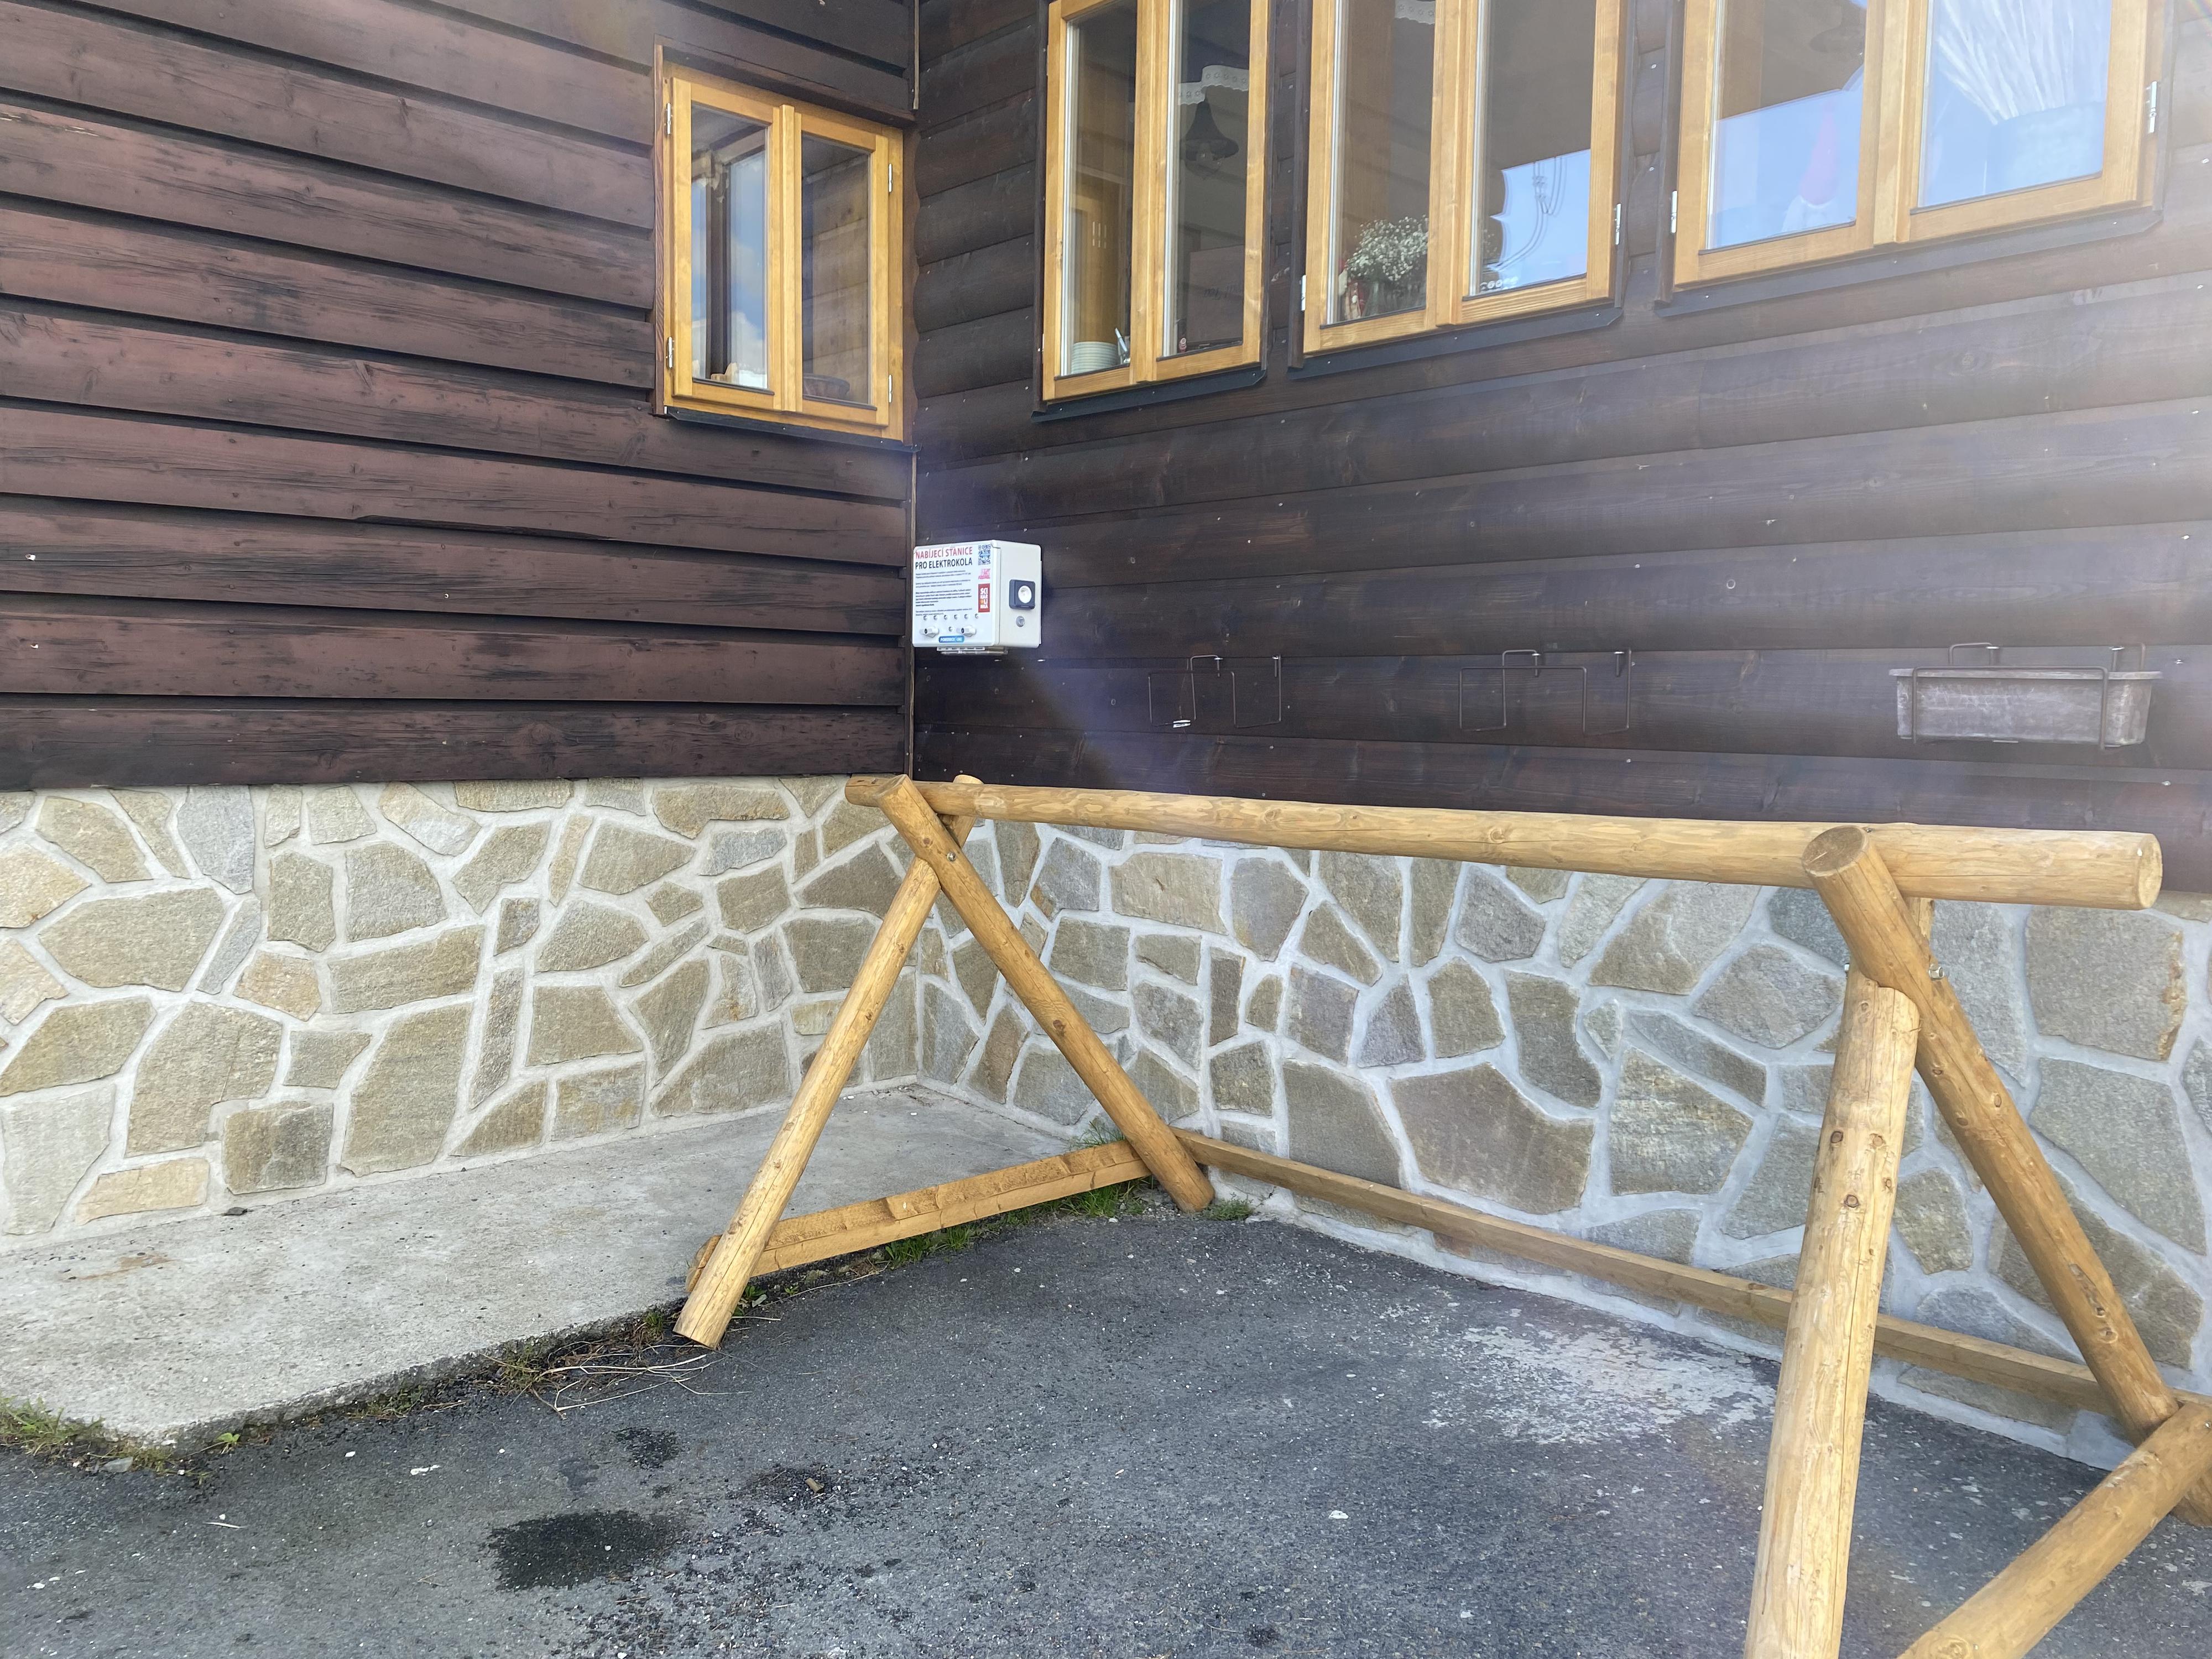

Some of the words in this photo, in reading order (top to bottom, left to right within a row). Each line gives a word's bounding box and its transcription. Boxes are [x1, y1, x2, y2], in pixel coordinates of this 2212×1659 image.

[916, 548, 943, 559] NABÍJECÍ
[946, 546, 973, 557] STANICE
[915, 561, 927, 570] PRO
[928, 557, 973, 568] ELEKTROKOLA
